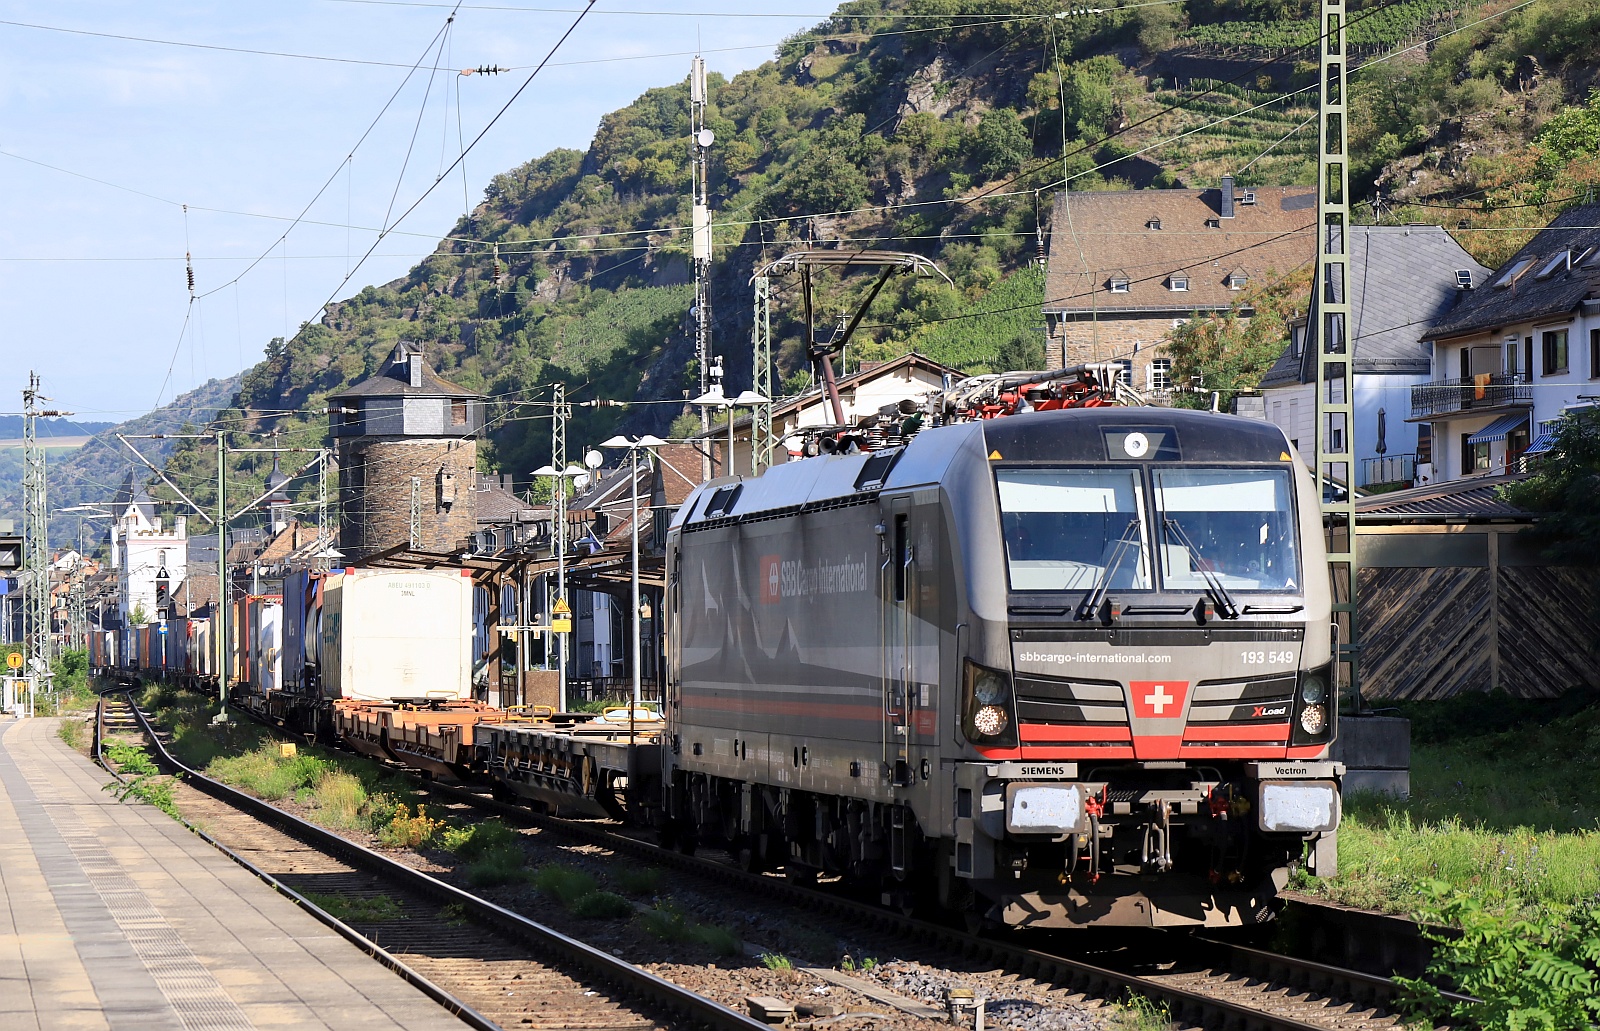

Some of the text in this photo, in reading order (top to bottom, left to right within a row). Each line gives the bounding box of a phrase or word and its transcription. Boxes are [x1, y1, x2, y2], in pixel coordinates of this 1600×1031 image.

[781, 552, 867, 604] SBB Cargo International
[11, 656, 19, 666] T
[1019, 651, 1172, 665] sbbcargo-international.com
[1240, 651, 1294, 664] 193 549
[1251, 705, 1287, 717] XLoad
[1021, 766, 1065, 776] SIEMENS
[1274, 766, 1307, 775] Vectron
